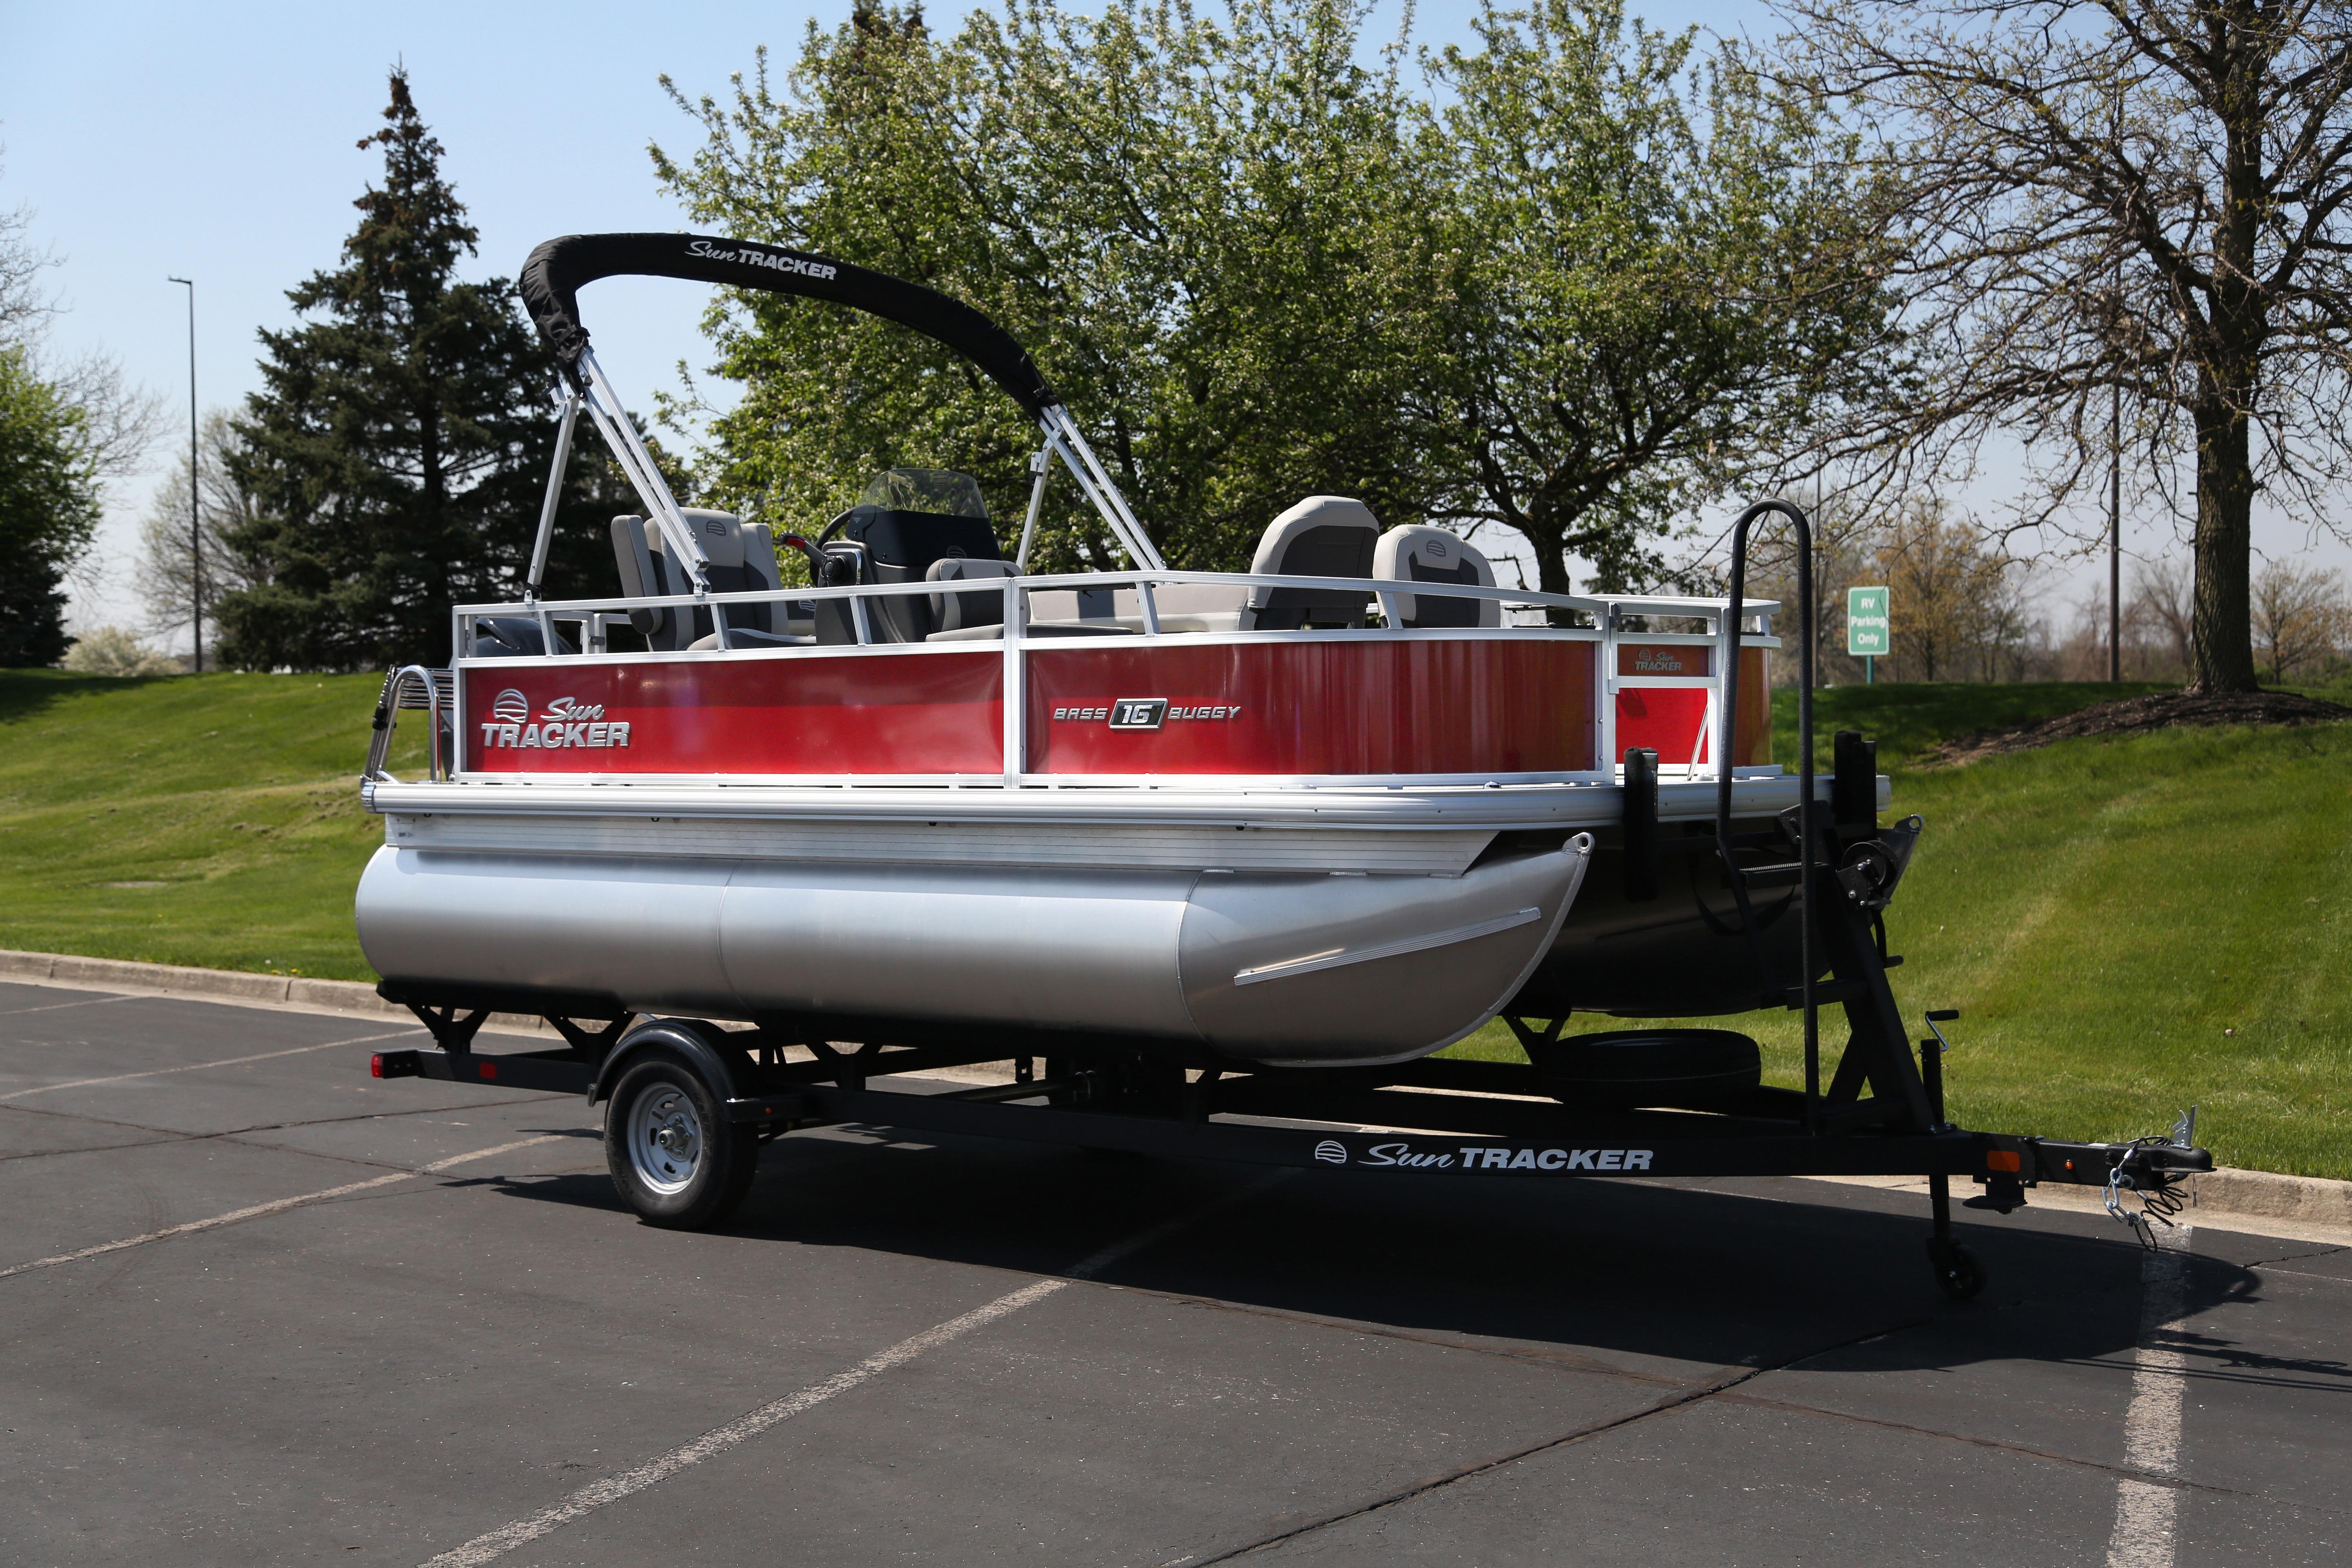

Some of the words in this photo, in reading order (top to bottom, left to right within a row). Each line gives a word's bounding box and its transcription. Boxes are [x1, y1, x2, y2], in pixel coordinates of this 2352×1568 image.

[685, 241, 736, 261] Sun
[739, 249, 836, 280] TRACKER
[1861, 597, 1875, 609] RV
[1851, 615, 1886, 629] Parking
[1858, 633, 1879, 646] Only
[1655, 652, 1674, 661] Sun
[1635, 662, 1682, 671] TRACKER
[540, 697, 605, 721] Sun
[1053, 708, 1108, 719] BASS
[1121, 705, 1153, 723] 16
[1168, 706, 1241, 719] BUGGY
[481, 722, 630, 748] TRACKER
[1357, 1144, 1454, 1168] Sun
[1459, 1148, 1653, 1169] TRACKER
